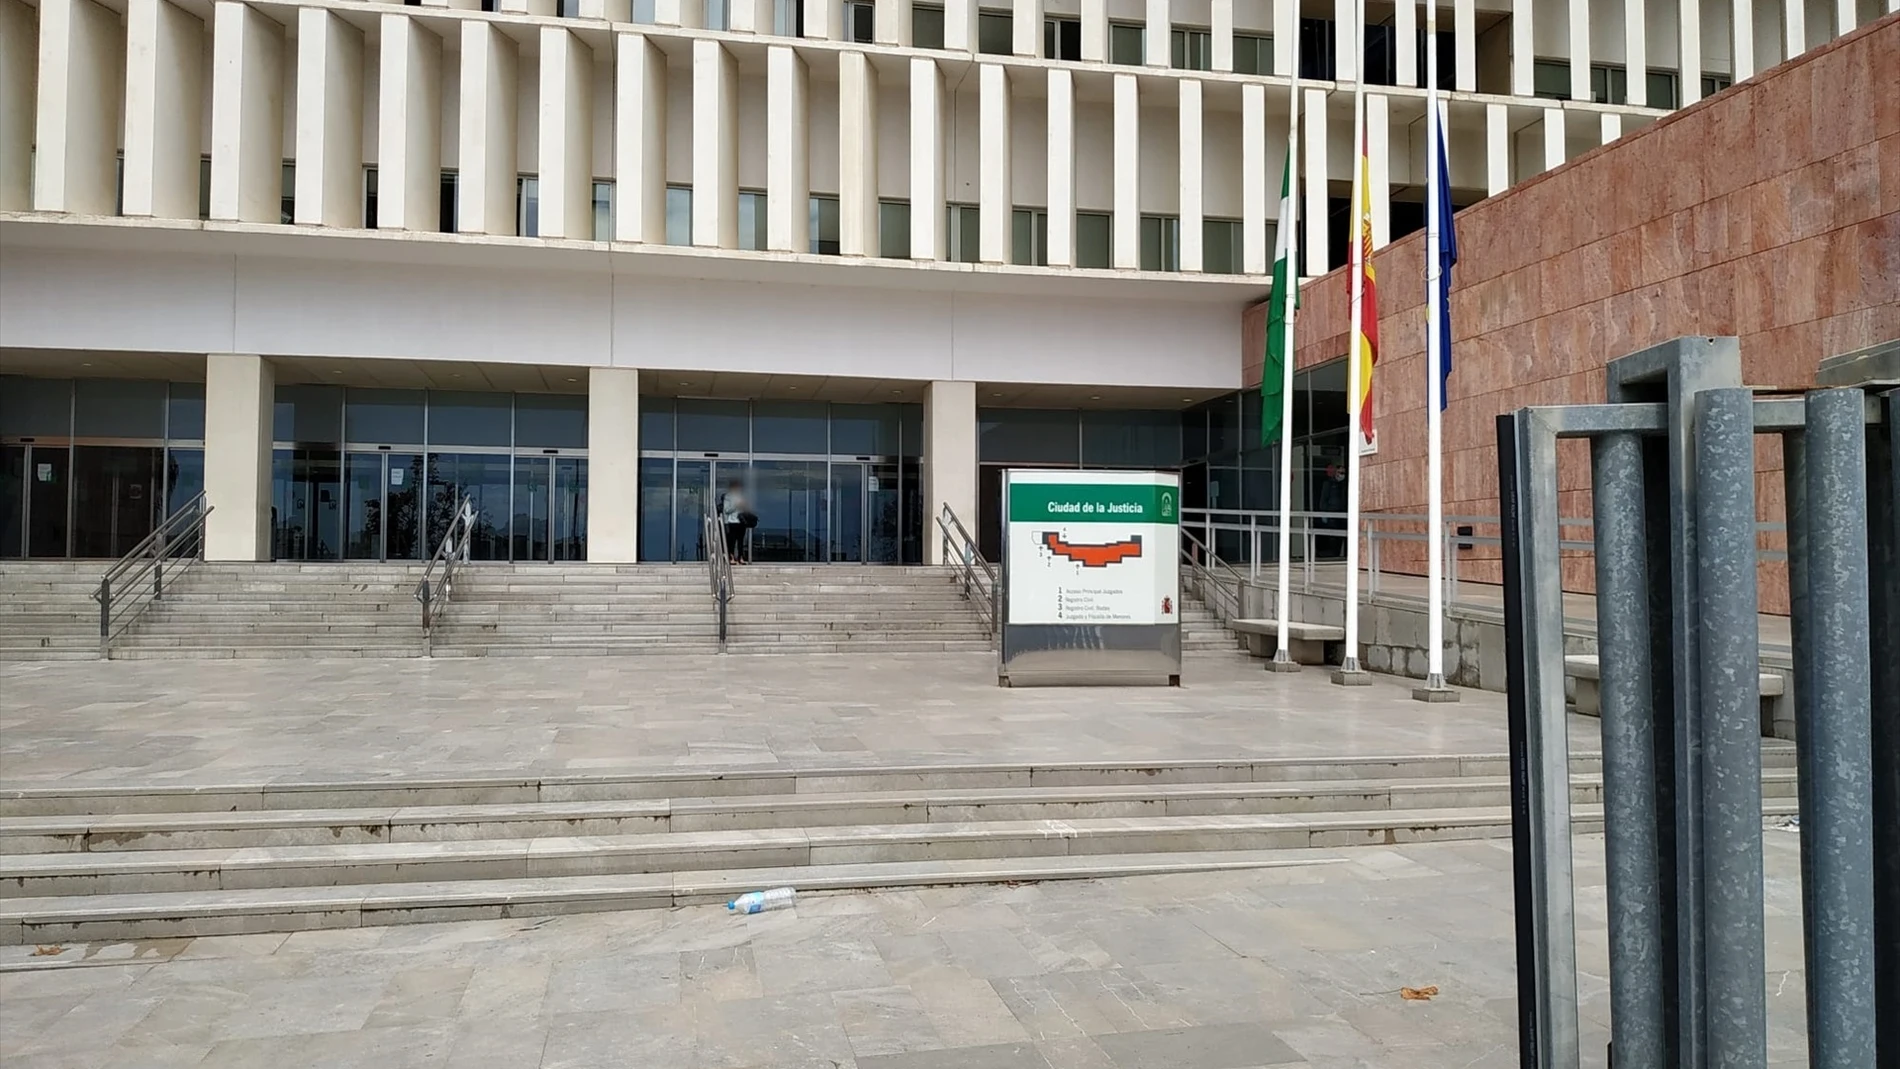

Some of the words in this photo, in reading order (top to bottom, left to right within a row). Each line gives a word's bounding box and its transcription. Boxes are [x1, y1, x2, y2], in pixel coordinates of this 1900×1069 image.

[1047, 501, 1081, 513] Ciudad
[1082, 501, 1094, 513] de
[1096, 501, 1105, 513] la
[1107, 501, 1143, 514] Justicia
[1058, 586, 1063, 594] 1
[1057, 594, 1063, 603] 2
[1057, 603, 1063, 611] 3
[1057, 611, 1063, 619] 4
